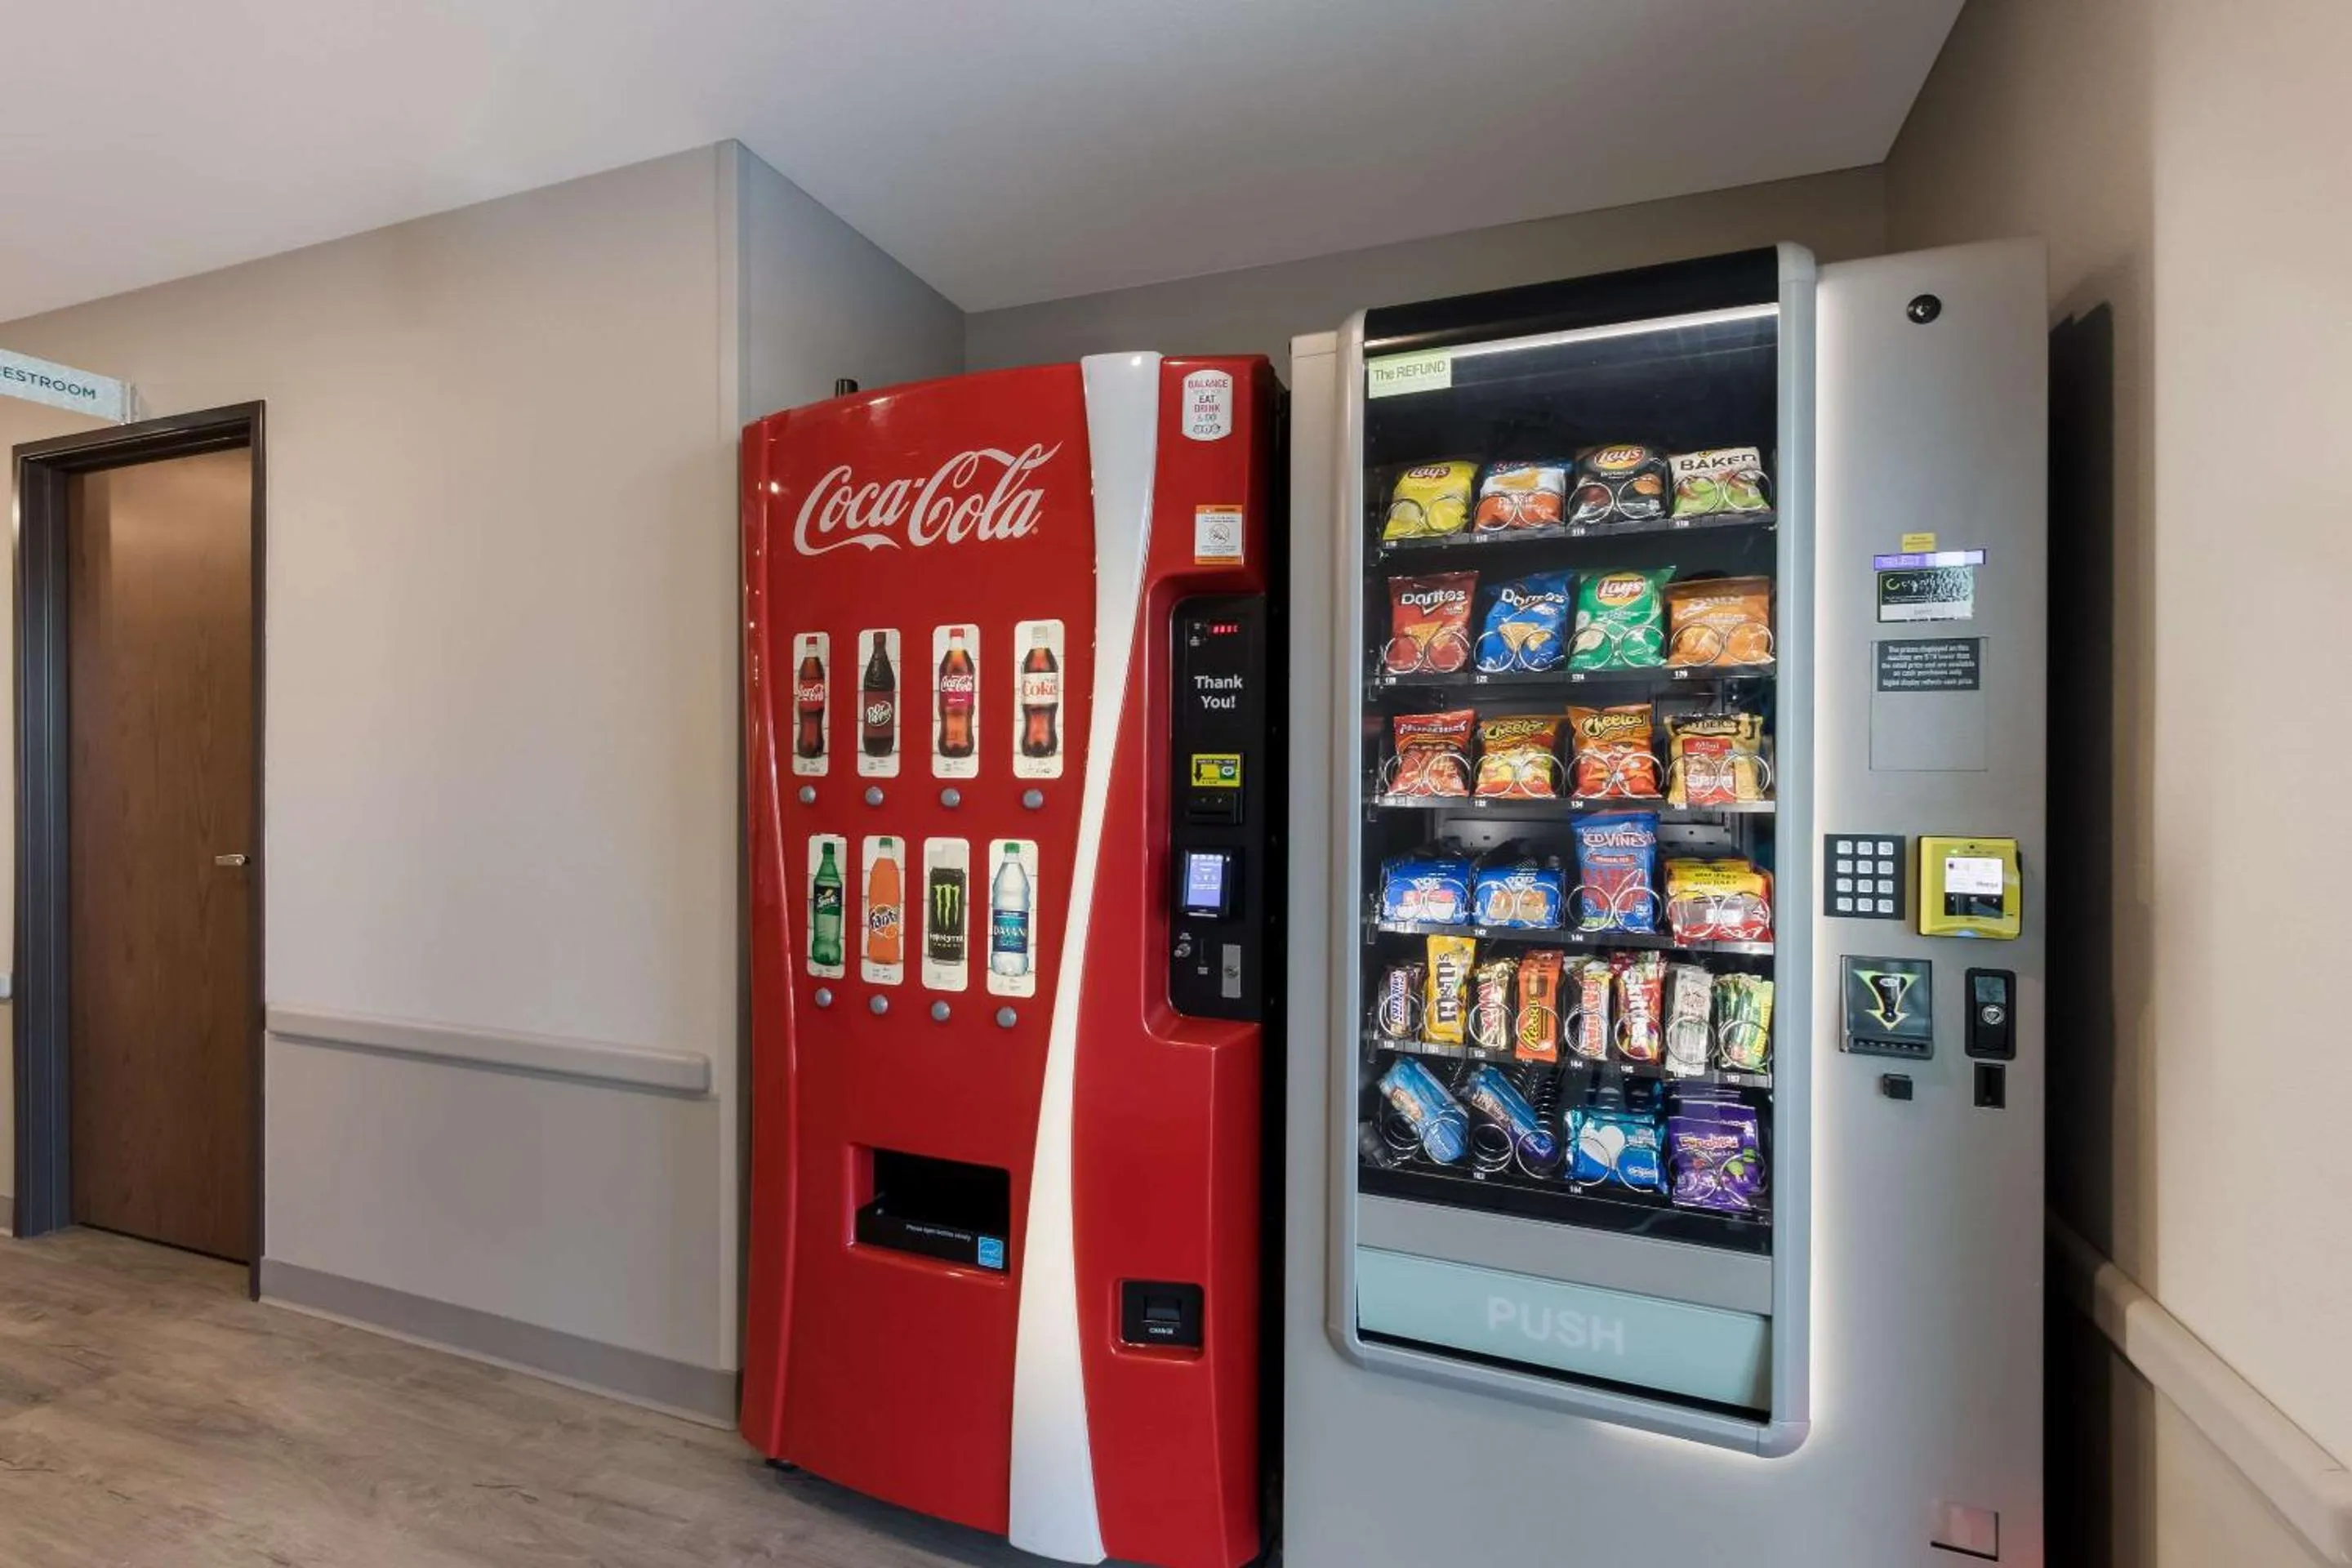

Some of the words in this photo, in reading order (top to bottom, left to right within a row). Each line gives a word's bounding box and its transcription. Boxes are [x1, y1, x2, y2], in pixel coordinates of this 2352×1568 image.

[1396, 359, 1446, 378] REFUND
[0, 366, 96, 399] ESTROOM
[1198, 394, 1217, 403] EAT
[794, 439, 1064, 556] Coca-Cola
[1401, 588, 1467, 606] Doritos
[1500, 587, 1566, 607] Doritos
[1194, 673, 1244, 690] Thank
[1200, 695, 1236, 710] You!
[1580, 712, 1647, 738] Cheetos
[1486, 1296, 1627, 1356] PUSH
